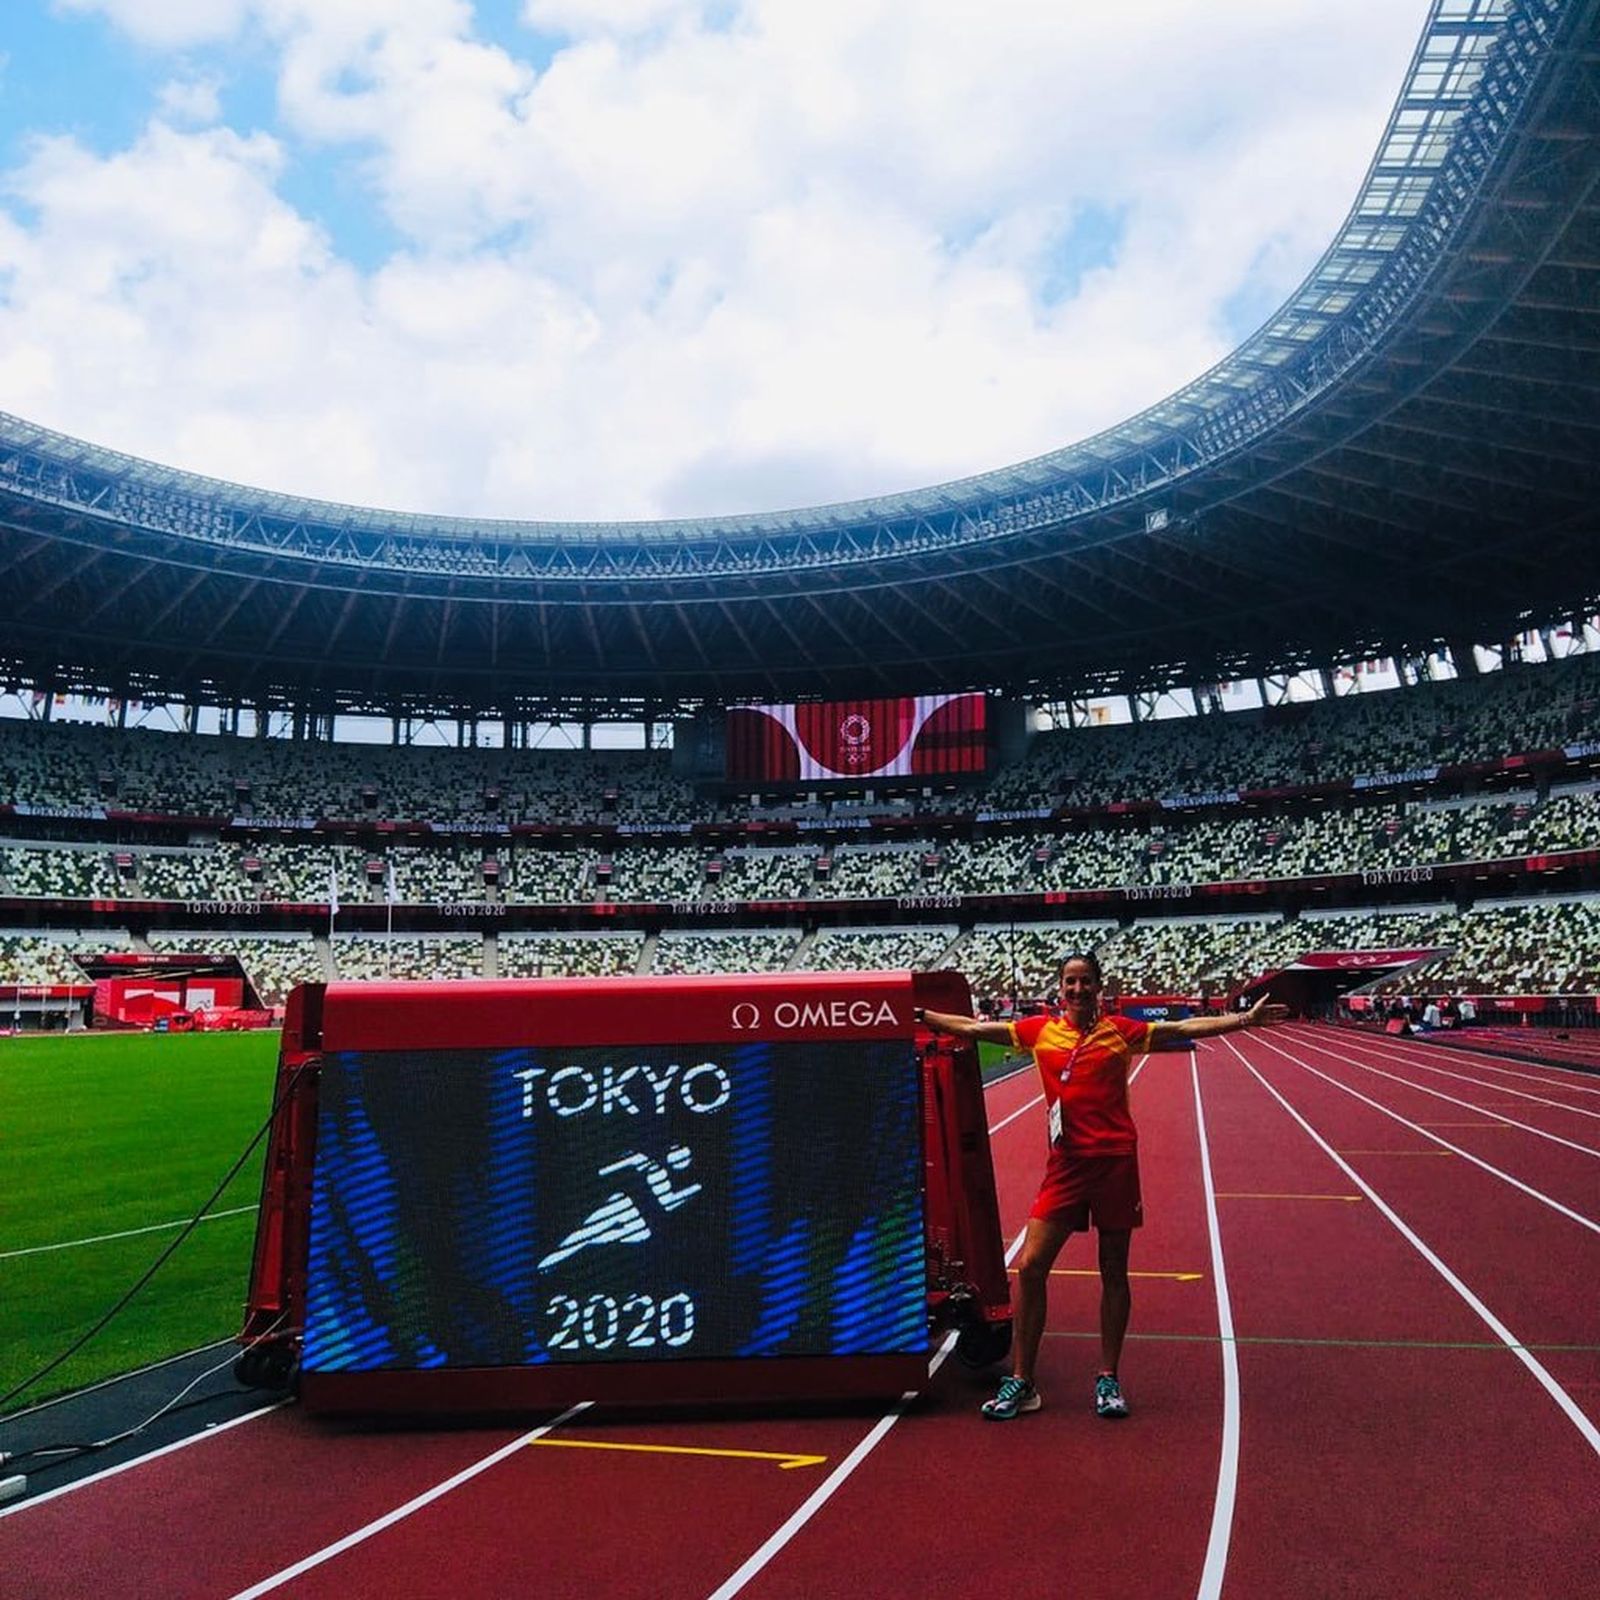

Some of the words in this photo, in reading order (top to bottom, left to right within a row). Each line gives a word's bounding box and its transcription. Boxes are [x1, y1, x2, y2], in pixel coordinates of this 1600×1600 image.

[1362, 870, 1401, 885] TOKYO
[1403, 867, 1433, 883] 2020
[1123, 888, 1161, 900] TOKYO
[1163, 885, 1192, 898] 2020
[186, 902, 227, 914] TOKYO
[230, 903, 260, 914] 2020
[438, 904, 476, 916] TOKYO
[477, 904, 505, 916] 2020
[672, 902, 707, 914] TOKYO
[710, 902, 737, 914] 2020
[896, 897, 933, 909] TOKYO
[935, 896, 961, 908] 2020
[774, 1000, 899, 1028] OMEGA
[512, 1062, 732, 1118] TOKYO
[547, 1293, 695, 1351] 2020
